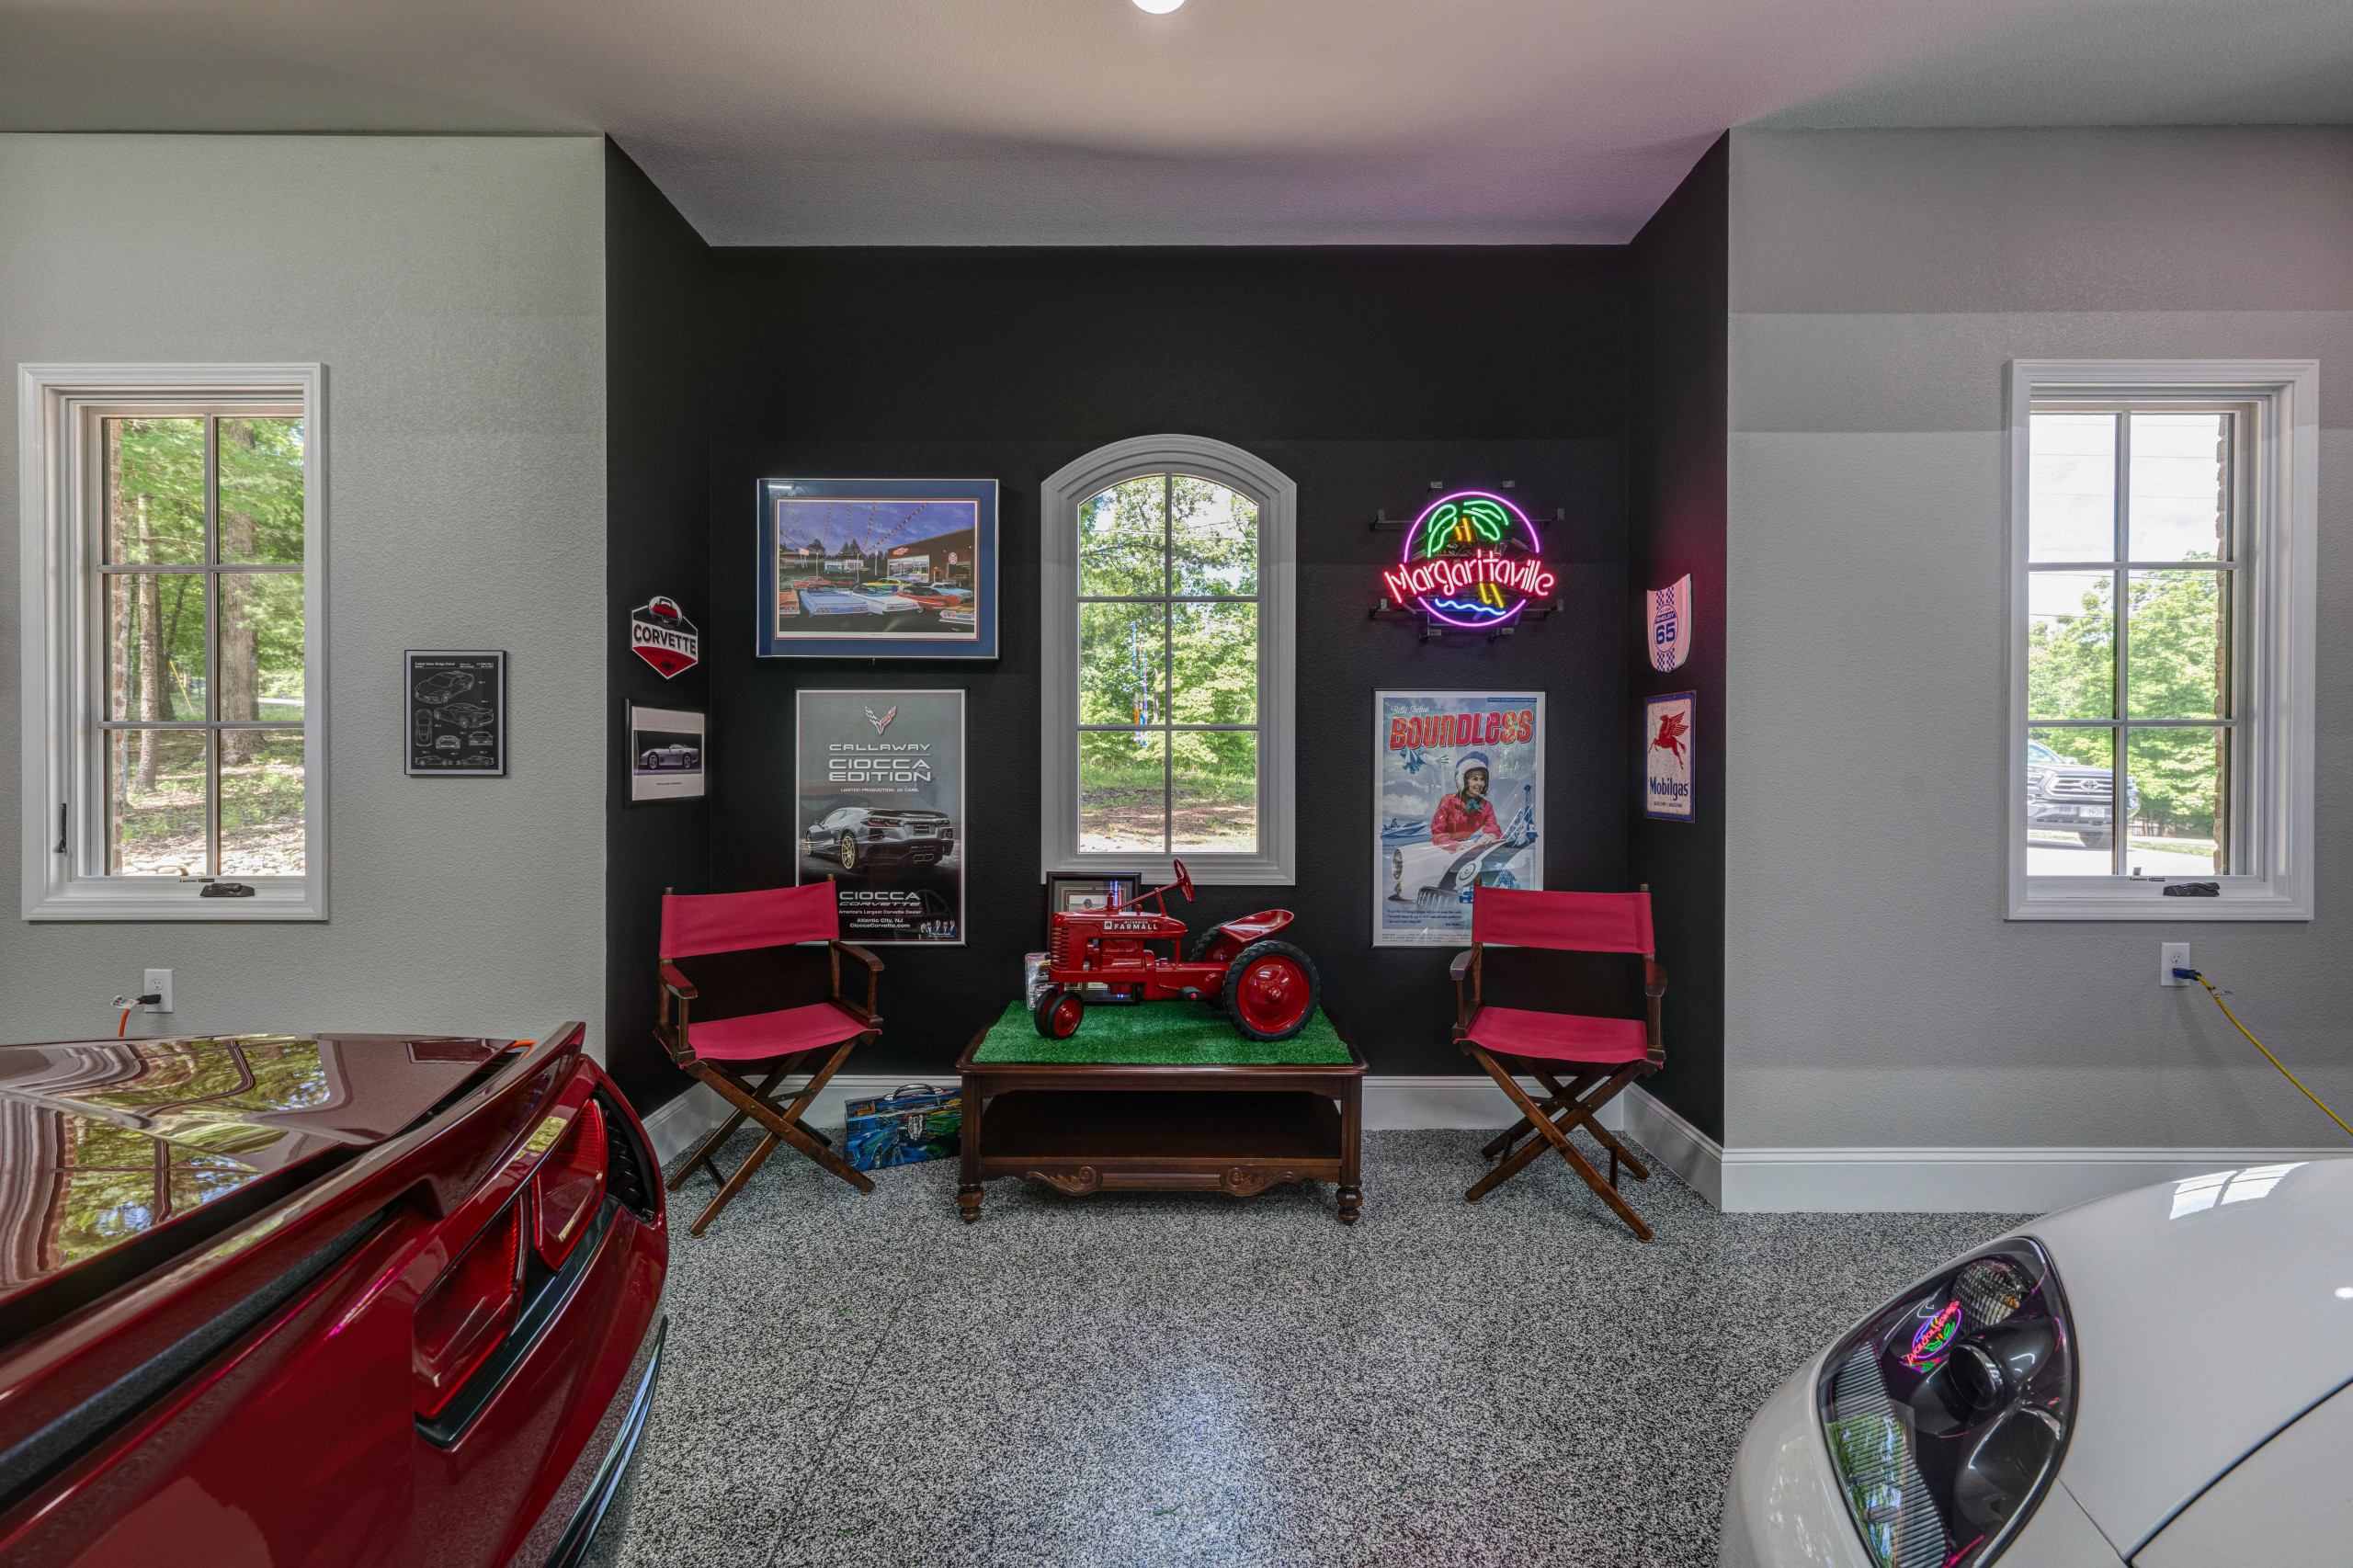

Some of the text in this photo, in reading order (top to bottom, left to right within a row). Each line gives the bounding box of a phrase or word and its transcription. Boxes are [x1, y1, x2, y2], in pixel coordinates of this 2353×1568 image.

[1383, 549, 1555, 603] Margaritaville
[633, 624, 697, 656] CORVETTE
[1656, 621, 1676, 644] 65
[829, 759, 931, 769] CIOCCA
[829, 771, 931, 782] EDITION
[1649, 777, 1688, 801] Mobilgas
[839, 892, 921, 900] CIOCCA
